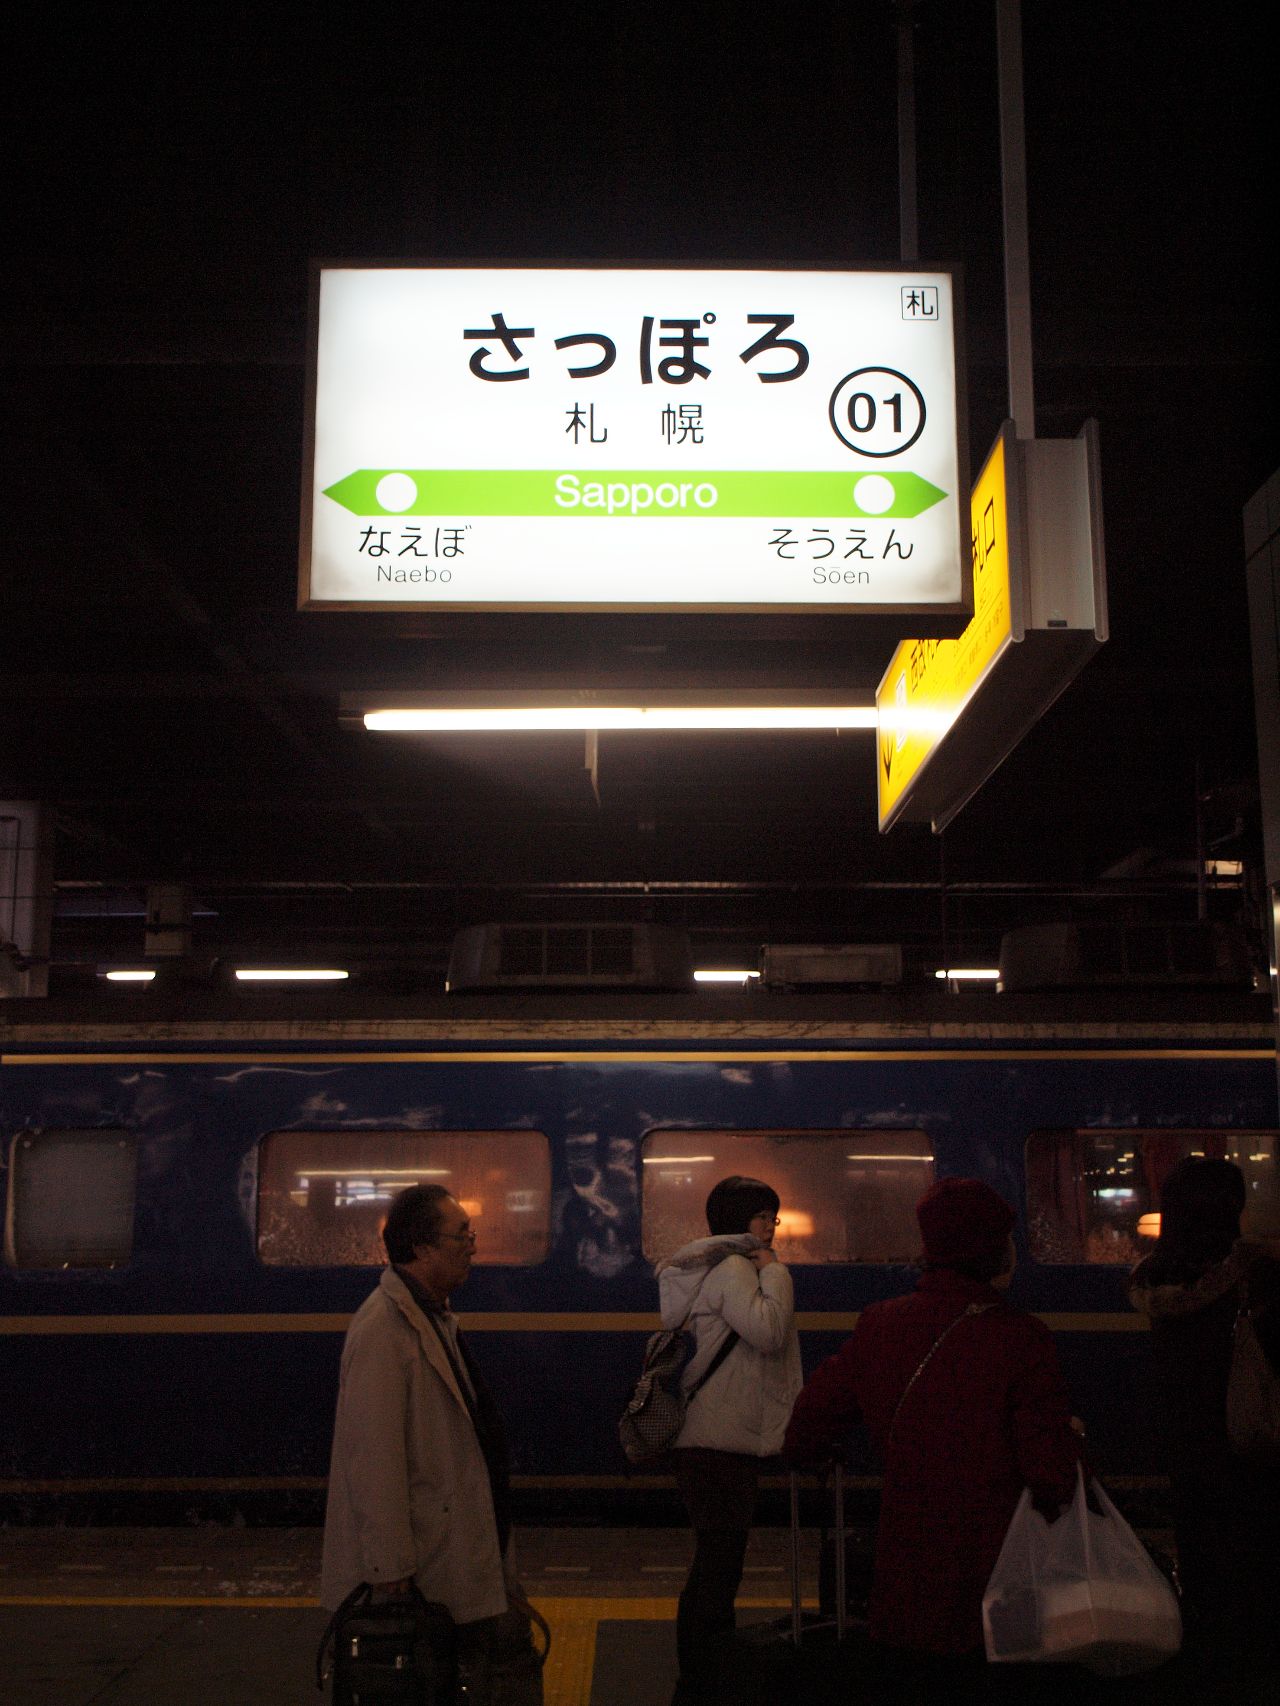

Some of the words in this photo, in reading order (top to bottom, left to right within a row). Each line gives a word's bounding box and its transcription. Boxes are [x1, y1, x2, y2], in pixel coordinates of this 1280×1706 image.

[907, 291, 934, 316] 札
[463, 312, 810, 385] さっぽろ
[565, 402, 704, 445] 札幌
[846, 392, 905, 433] 01
[554, 474, 718, 515] Sapporo
[358, 525, 472, 558] なえぼ
[767, 528, 914, 560] そうえん
[377, 564, 452, 583] Naebo
[813, 566, 870, 584] Sōen
